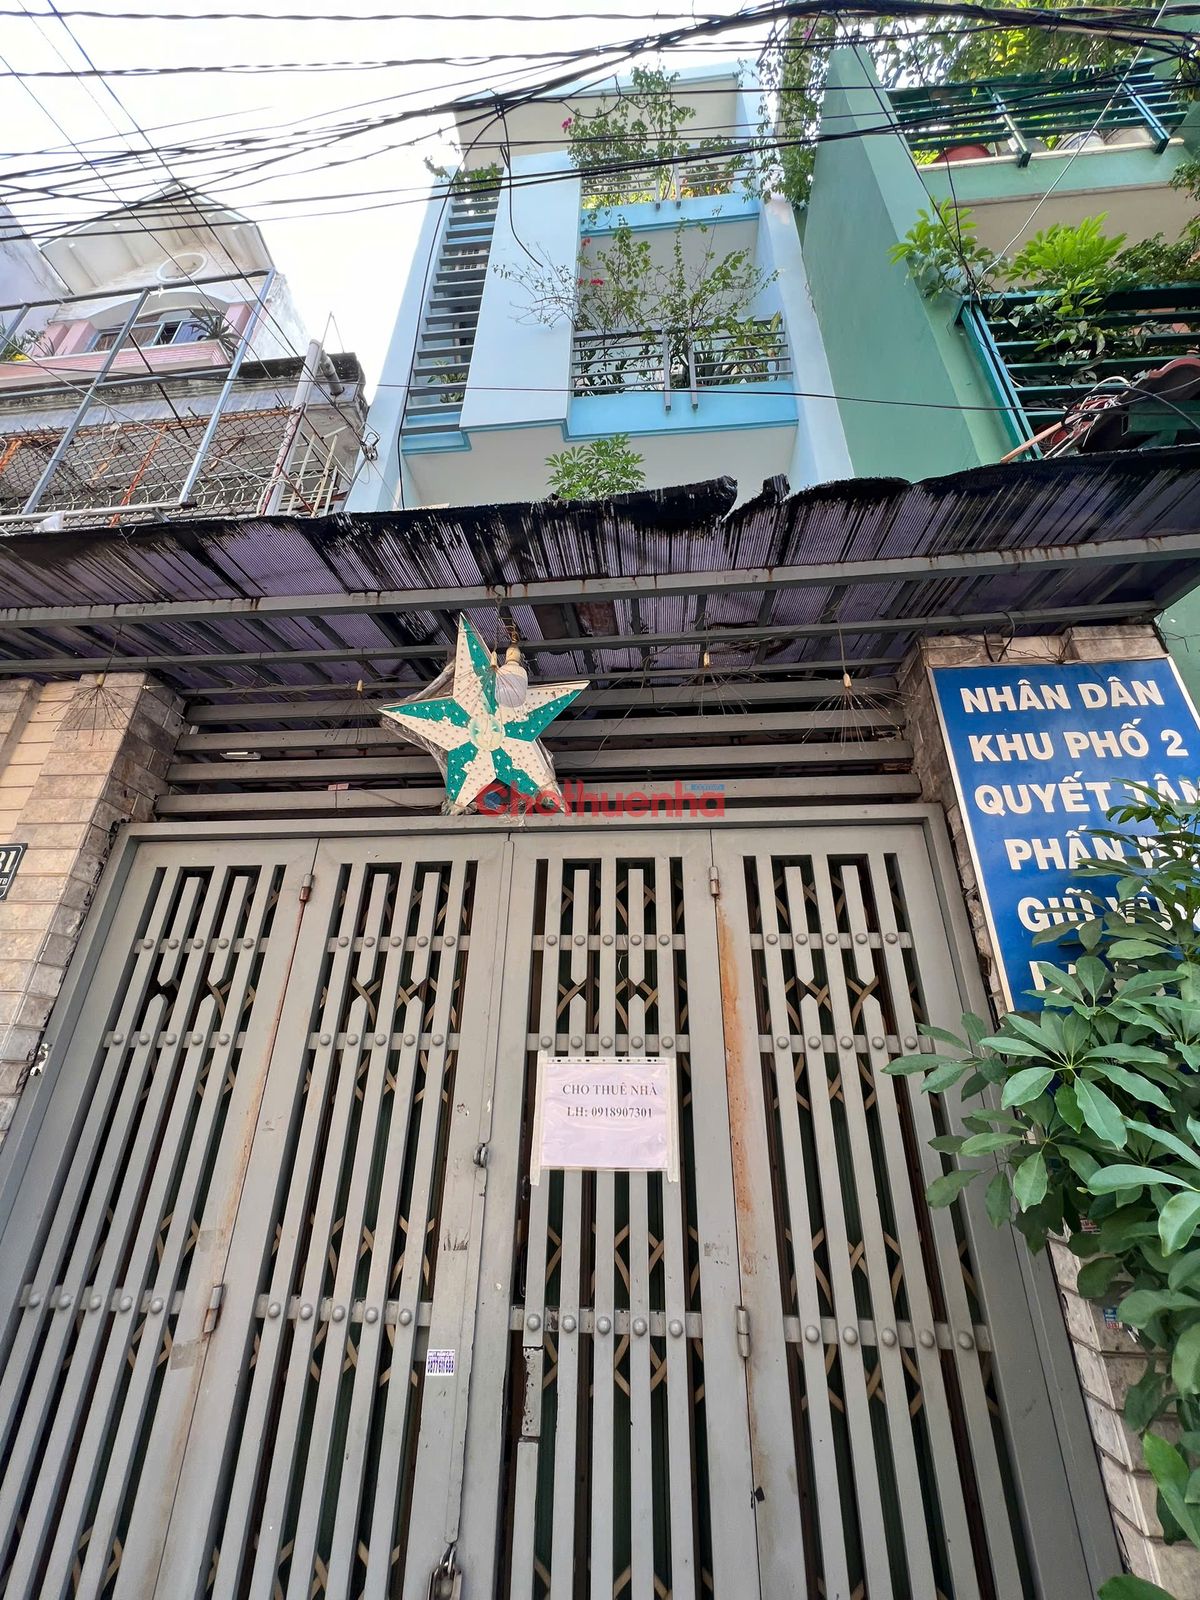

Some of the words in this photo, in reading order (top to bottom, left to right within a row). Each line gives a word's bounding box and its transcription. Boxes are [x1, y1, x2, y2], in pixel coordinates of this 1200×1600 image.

[960, 679, 1071, 713] NHÂN
[1078, 676, 1165, 709] DÂN
[968, 732, 1055, 762] KHU
[1063, 718, 1149, 758] PHỐ
[1160, 729, 1189, 757] 2
[974, 771, 1111, 816] QUYẾT
[1004, 825, 1127, 870] PHẤN
[562, 1084, 590, 1096] CHO
[592, 1082, 627, 1096] THUÊ
[630, 1082, 657, 1096] NHÀ
[567, 1106, 588, 1117] LH:
[591, 1106, 652, 1118] 0918907301
